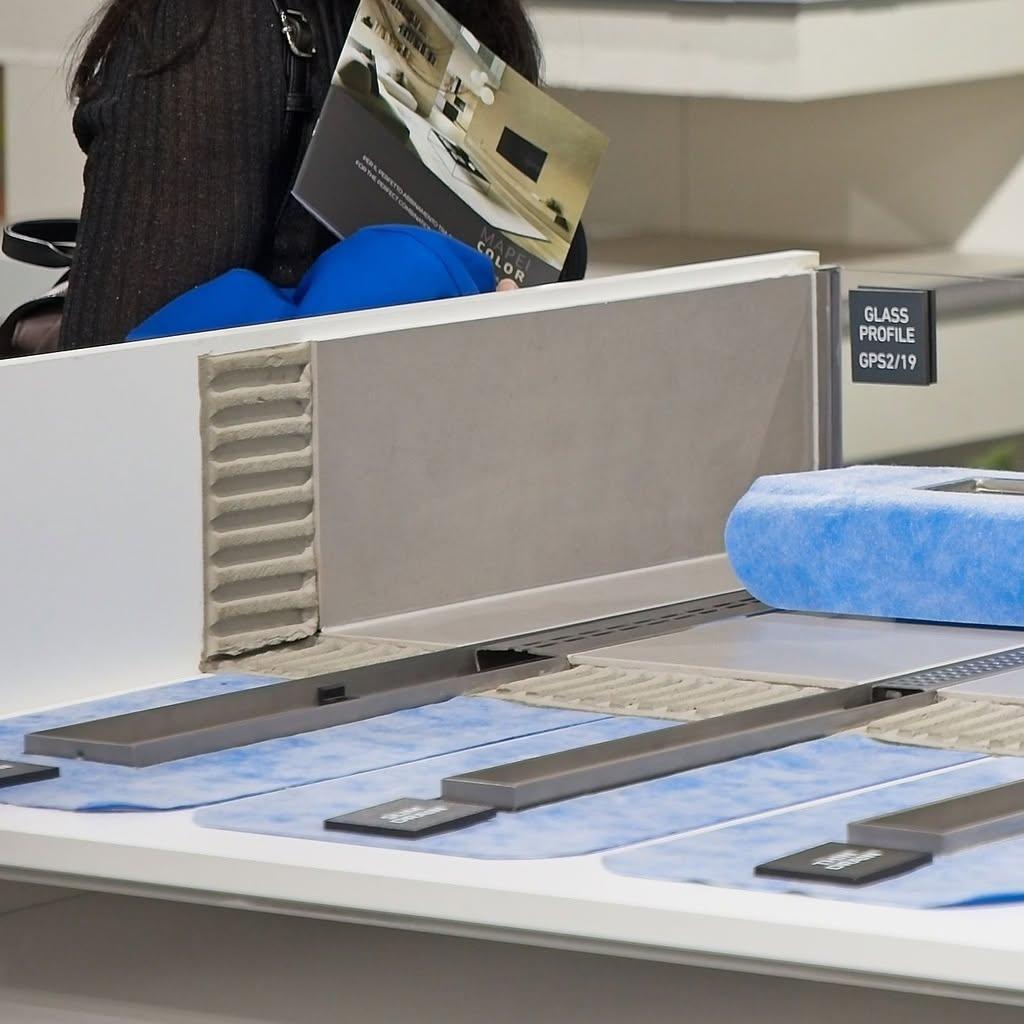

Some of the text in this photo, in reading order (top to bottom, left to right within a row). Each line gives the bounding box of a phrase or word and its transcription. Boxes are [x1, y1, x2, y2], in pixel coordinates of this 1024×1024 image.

[355, 159, 367, 173] FOR
[366, 169, 377, 182] THE
[376, 179, 399, 202] PERFECT
[480, 225, 532, 273] MAPEI
[864, 305, 910, 324] GLASS
[859, 325, 916, 344] PROFILE
[858, 351, 917, 371] GPS2/19
